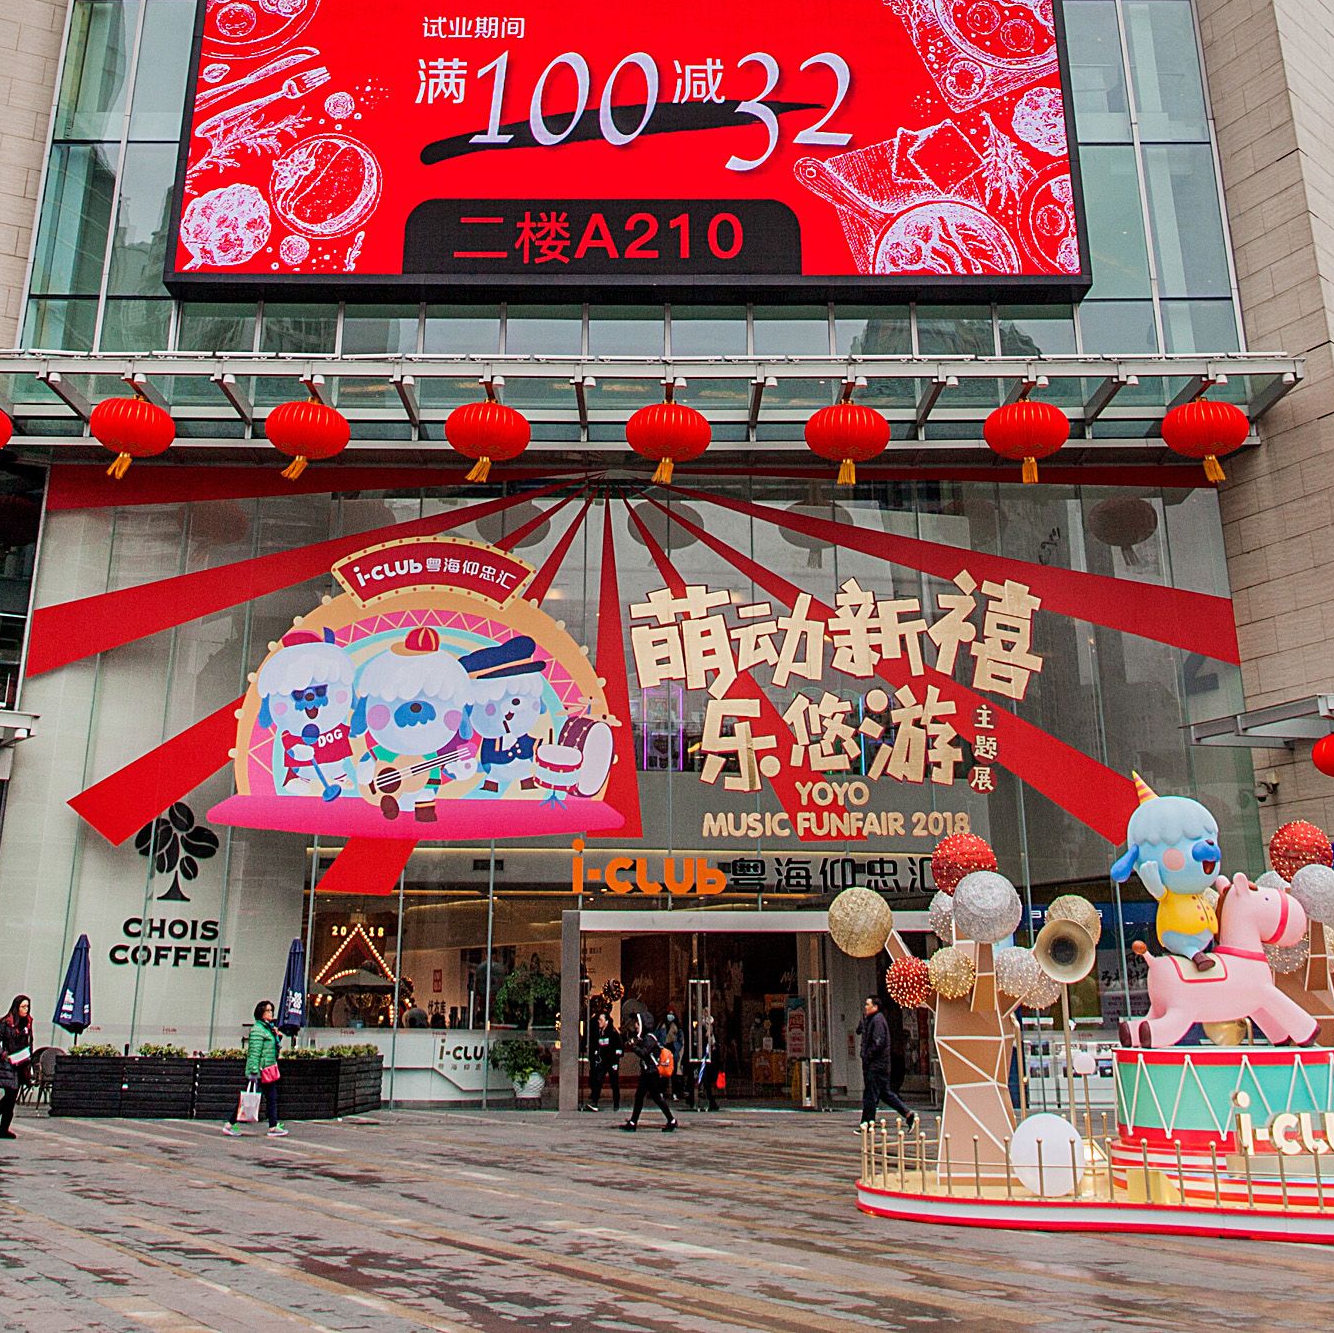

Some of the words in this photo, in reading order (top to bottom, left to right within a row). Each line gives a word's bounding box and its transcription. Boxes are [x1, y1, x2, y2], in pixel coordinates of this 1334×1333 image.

[423, 16, 526, 40] 试业期间
[453, 211, 745, 264] 二楼A210
[426, 557, 517, 589] 粤海仰忠汇
[629, 569, 1043, 700] 萌动新禧
[318, 729, 343, 747] DOG
[700, 684, 964, 793] 乐悠游
[970, 704, 998, 791] 主题展
[795, 781, 870, 806] YOYO
[702, 812, 791, 838] MUSIC
[796, 811, 906, 838] FUNFAIR
[912, 811, 971, 836] 2018
[123, 917, 219, 941] CHOIS
[109, 944, 231, 968] COFFEE
[438, 1038, 486, 1061] i-CLU
